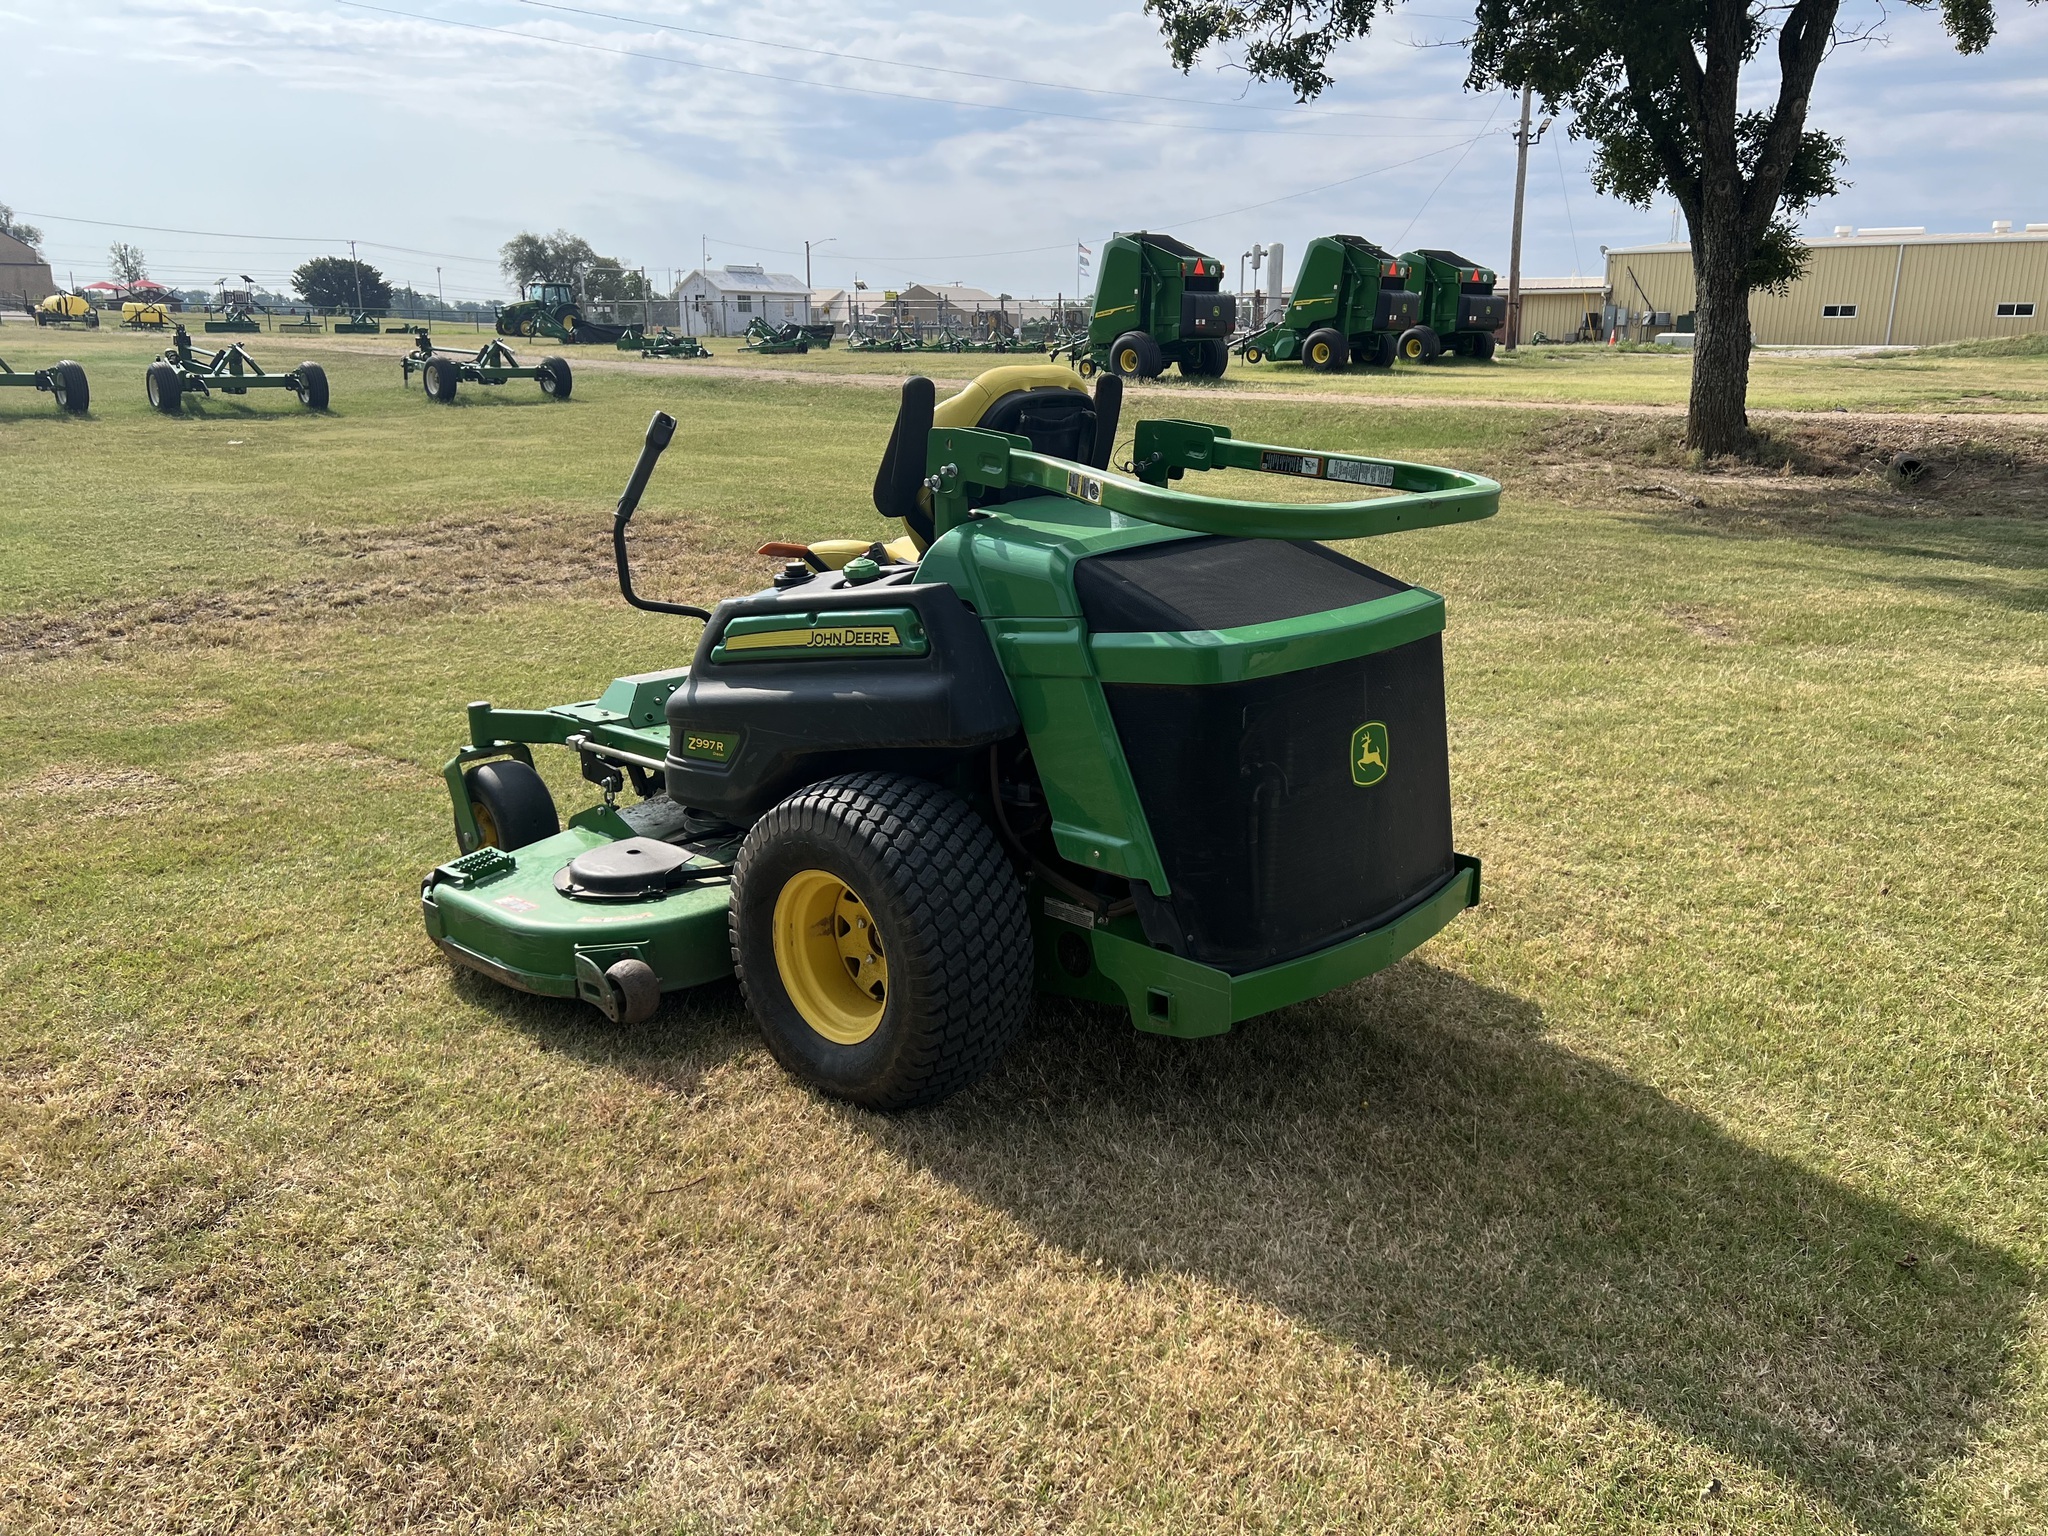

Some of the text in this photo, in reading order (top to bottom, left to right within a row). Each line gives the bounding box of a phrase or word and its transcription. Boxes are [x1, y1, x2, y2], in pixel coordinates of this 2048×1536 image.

[807, 629, 890, 645] JOHN DEERE
[688, 737, 724, 752] Z997R
